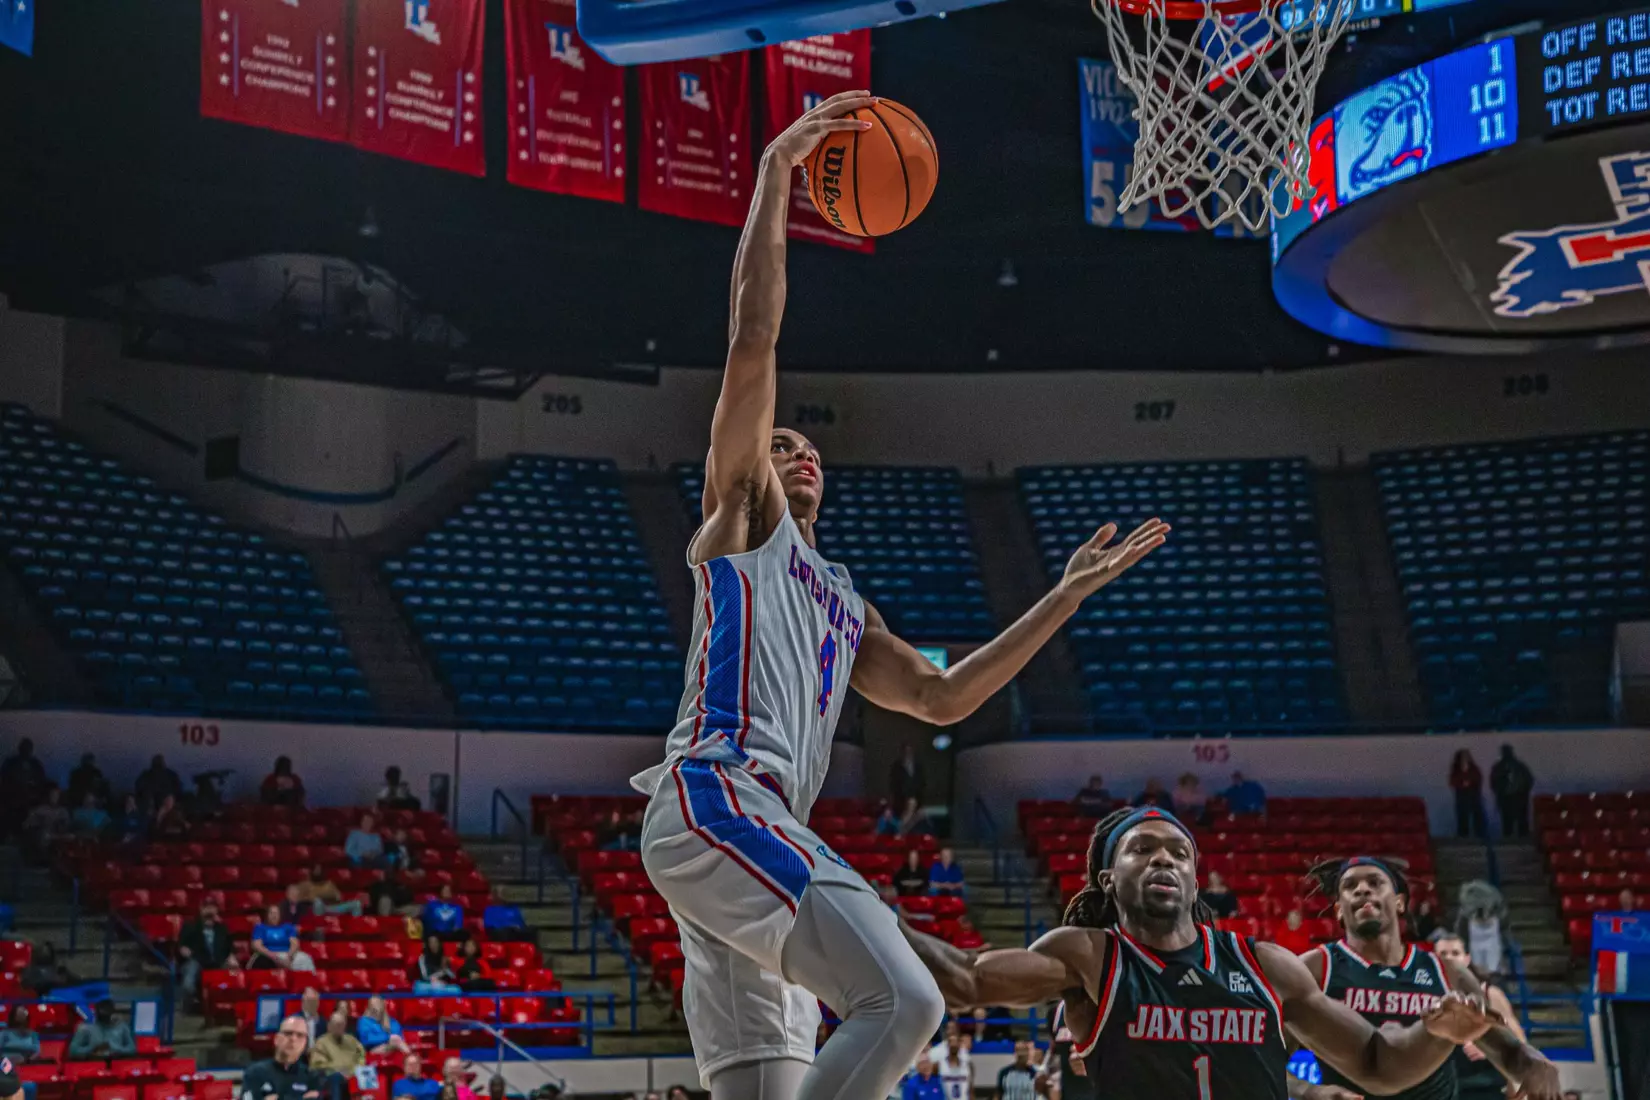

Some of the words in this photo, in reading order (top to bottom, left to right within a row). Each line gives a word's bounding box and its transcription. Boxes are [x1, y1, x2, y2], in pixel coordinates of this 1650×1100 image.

[1542, 22, 1596, 59] OFF
[1606, 12, 1650, 46] RE
[1489, 43, 1502, 74] 1
[1543, 56, 1601, 94] DEF
[1470, 77, 1506, 113] 10
[1545, 91, 1599, 126] TOT
[1607, 82, 1650, 116] RE
[1479, 111, 1505, 144] 11
[822, 145, 847, 228] Wilson
[1134, 400, 1176, 422] 207
[180, 723, 220, 747] 103
[1345, 987, 1381, 1013] JAX
[1127, 1004, 1186, 1041] JAX
[1189, 1008, 1268, 1045] STATE
[1193, 1055, 1212, 1100] 1
